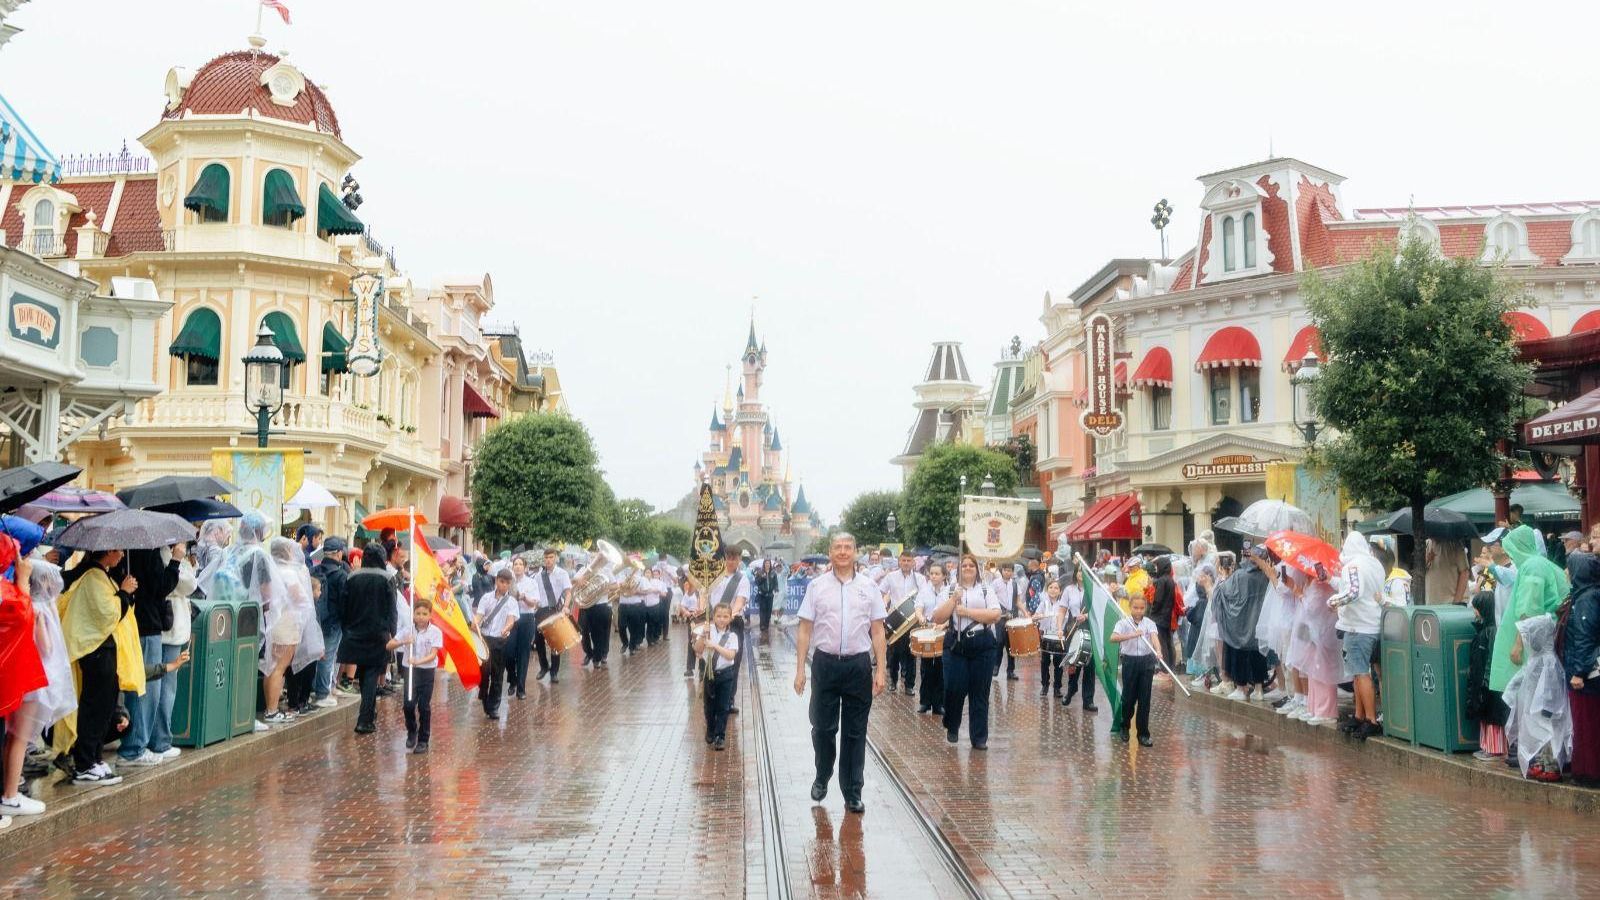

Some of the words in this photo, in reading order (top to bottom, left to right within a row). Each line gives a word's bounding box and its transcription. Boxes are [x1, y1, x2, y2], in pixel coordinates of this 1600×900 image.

[1096, 325, 1106, 372] MARKET
[1097, 376, 1107, 414] HOUSE
[1088, 415, 1117, 426] DELI
[1532, 417, 1600, 438] DEPEND
[1186, 461, 1281, 477] DELICATESSE
